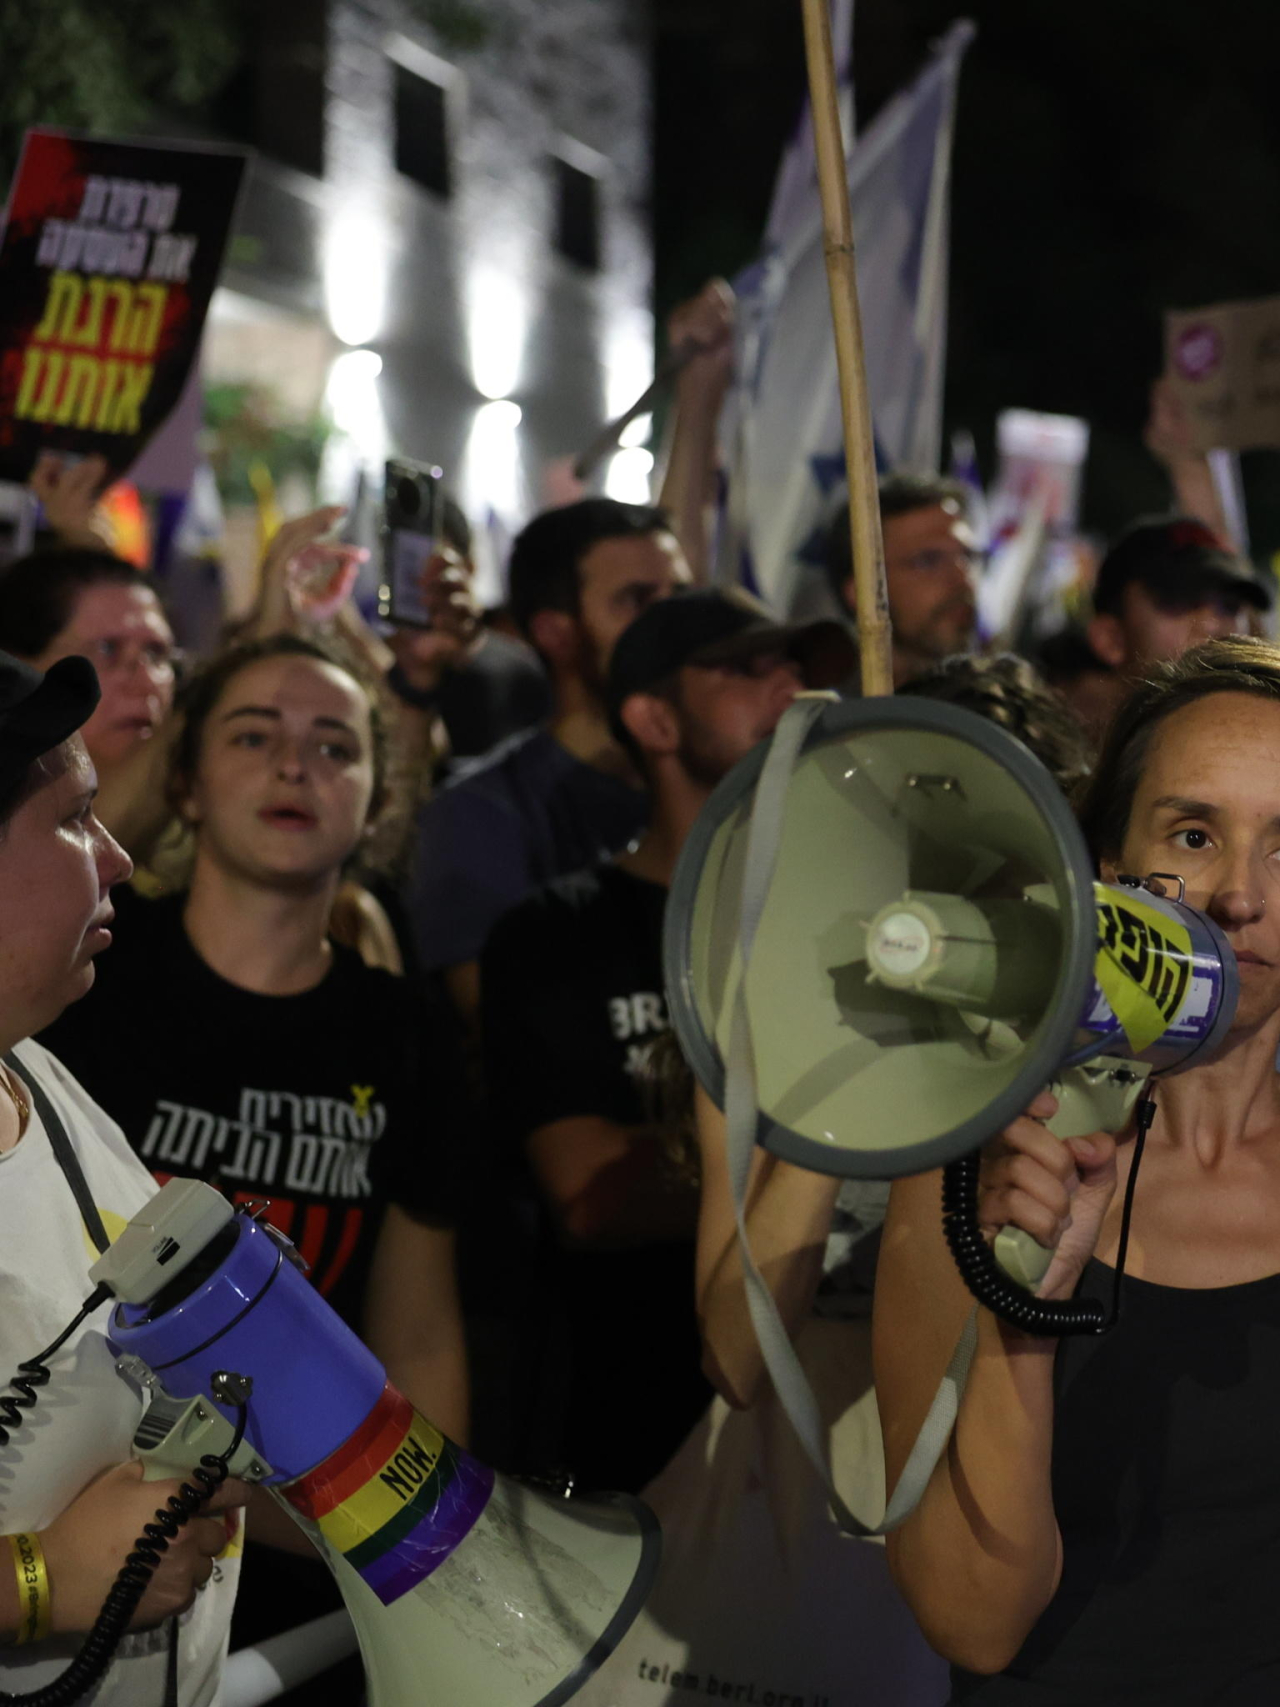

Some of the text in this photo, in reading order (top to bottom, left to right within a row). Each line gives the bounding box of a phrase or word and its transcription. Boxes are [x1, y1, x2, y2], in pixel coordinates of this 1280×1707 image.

[14, 347, 156, 435] אותנו
[140, 1099, 282, 1186] הביתה
[379, 1436, 437, 1501] NOW.
